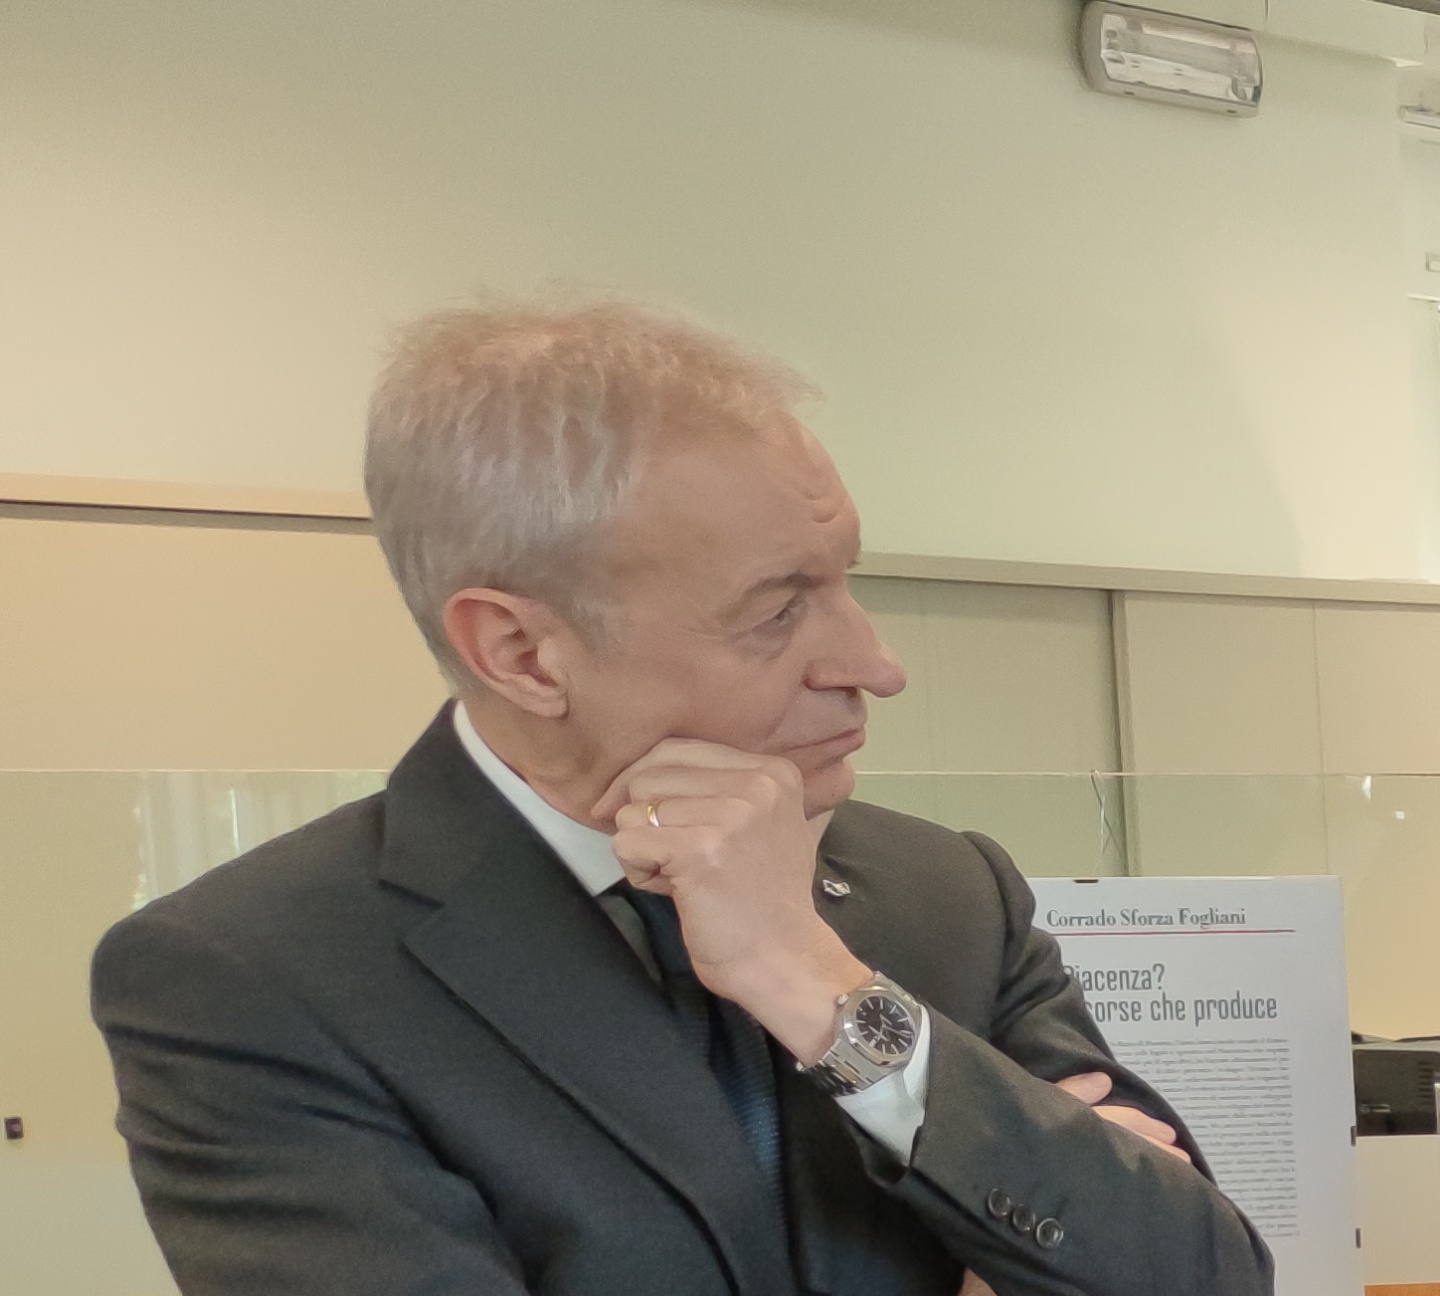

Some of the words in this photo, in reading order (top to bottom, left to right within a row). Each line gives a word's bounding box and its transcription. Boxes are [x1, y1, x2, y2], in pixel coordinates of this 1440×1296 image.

[1045, 909, 1117, 928] Corrado
[1120, 908, 1175, 927] Sforza
[1177, 907, 1247, 930] Fogliani
[1150, 991, 1187, 1022] che
[1194, 989, 1279, 1028] produce
